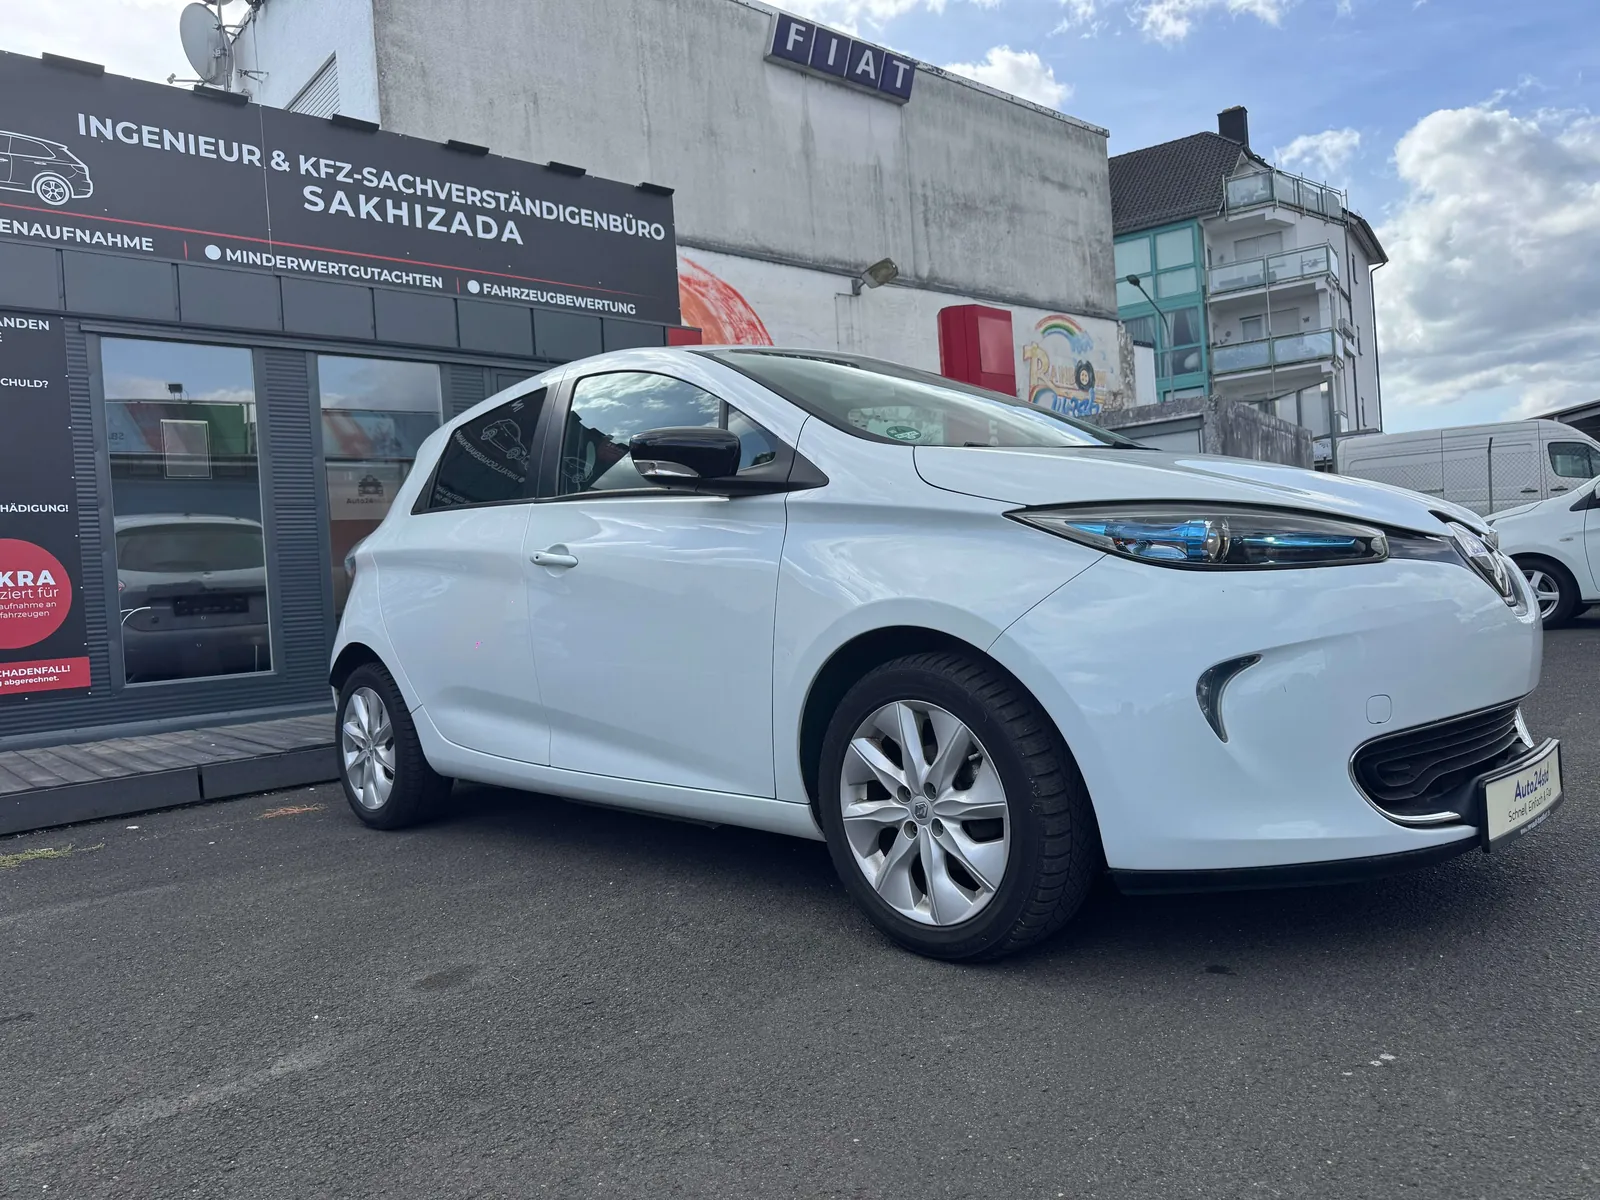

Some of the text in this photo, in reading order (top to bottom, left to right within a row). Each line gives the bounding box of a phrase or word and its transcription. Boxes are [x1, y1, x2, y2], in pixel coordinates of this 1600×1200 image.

[786, 22, 910, 89] FIAT
[77, 112, 666, 241] INGENIEUR & KFZ-SACHVERSTÄNDIGENBÜRO
[302, 185, 524, 245] SAKHIZADA
[225, 248, 443, 289] MINDERWERTGUTACHTEN
[482, 282, 637, 315] FAHRZEUGBEWERTUNG
[0, 502, 69, 513] HÄDIGUNG!
[38, 586, 60, 598] für
[45, 601, 57, 610] an
[0, 664, 71, 678] HADENFALL!
[4, 675, 60, 686] abgerechnet.
